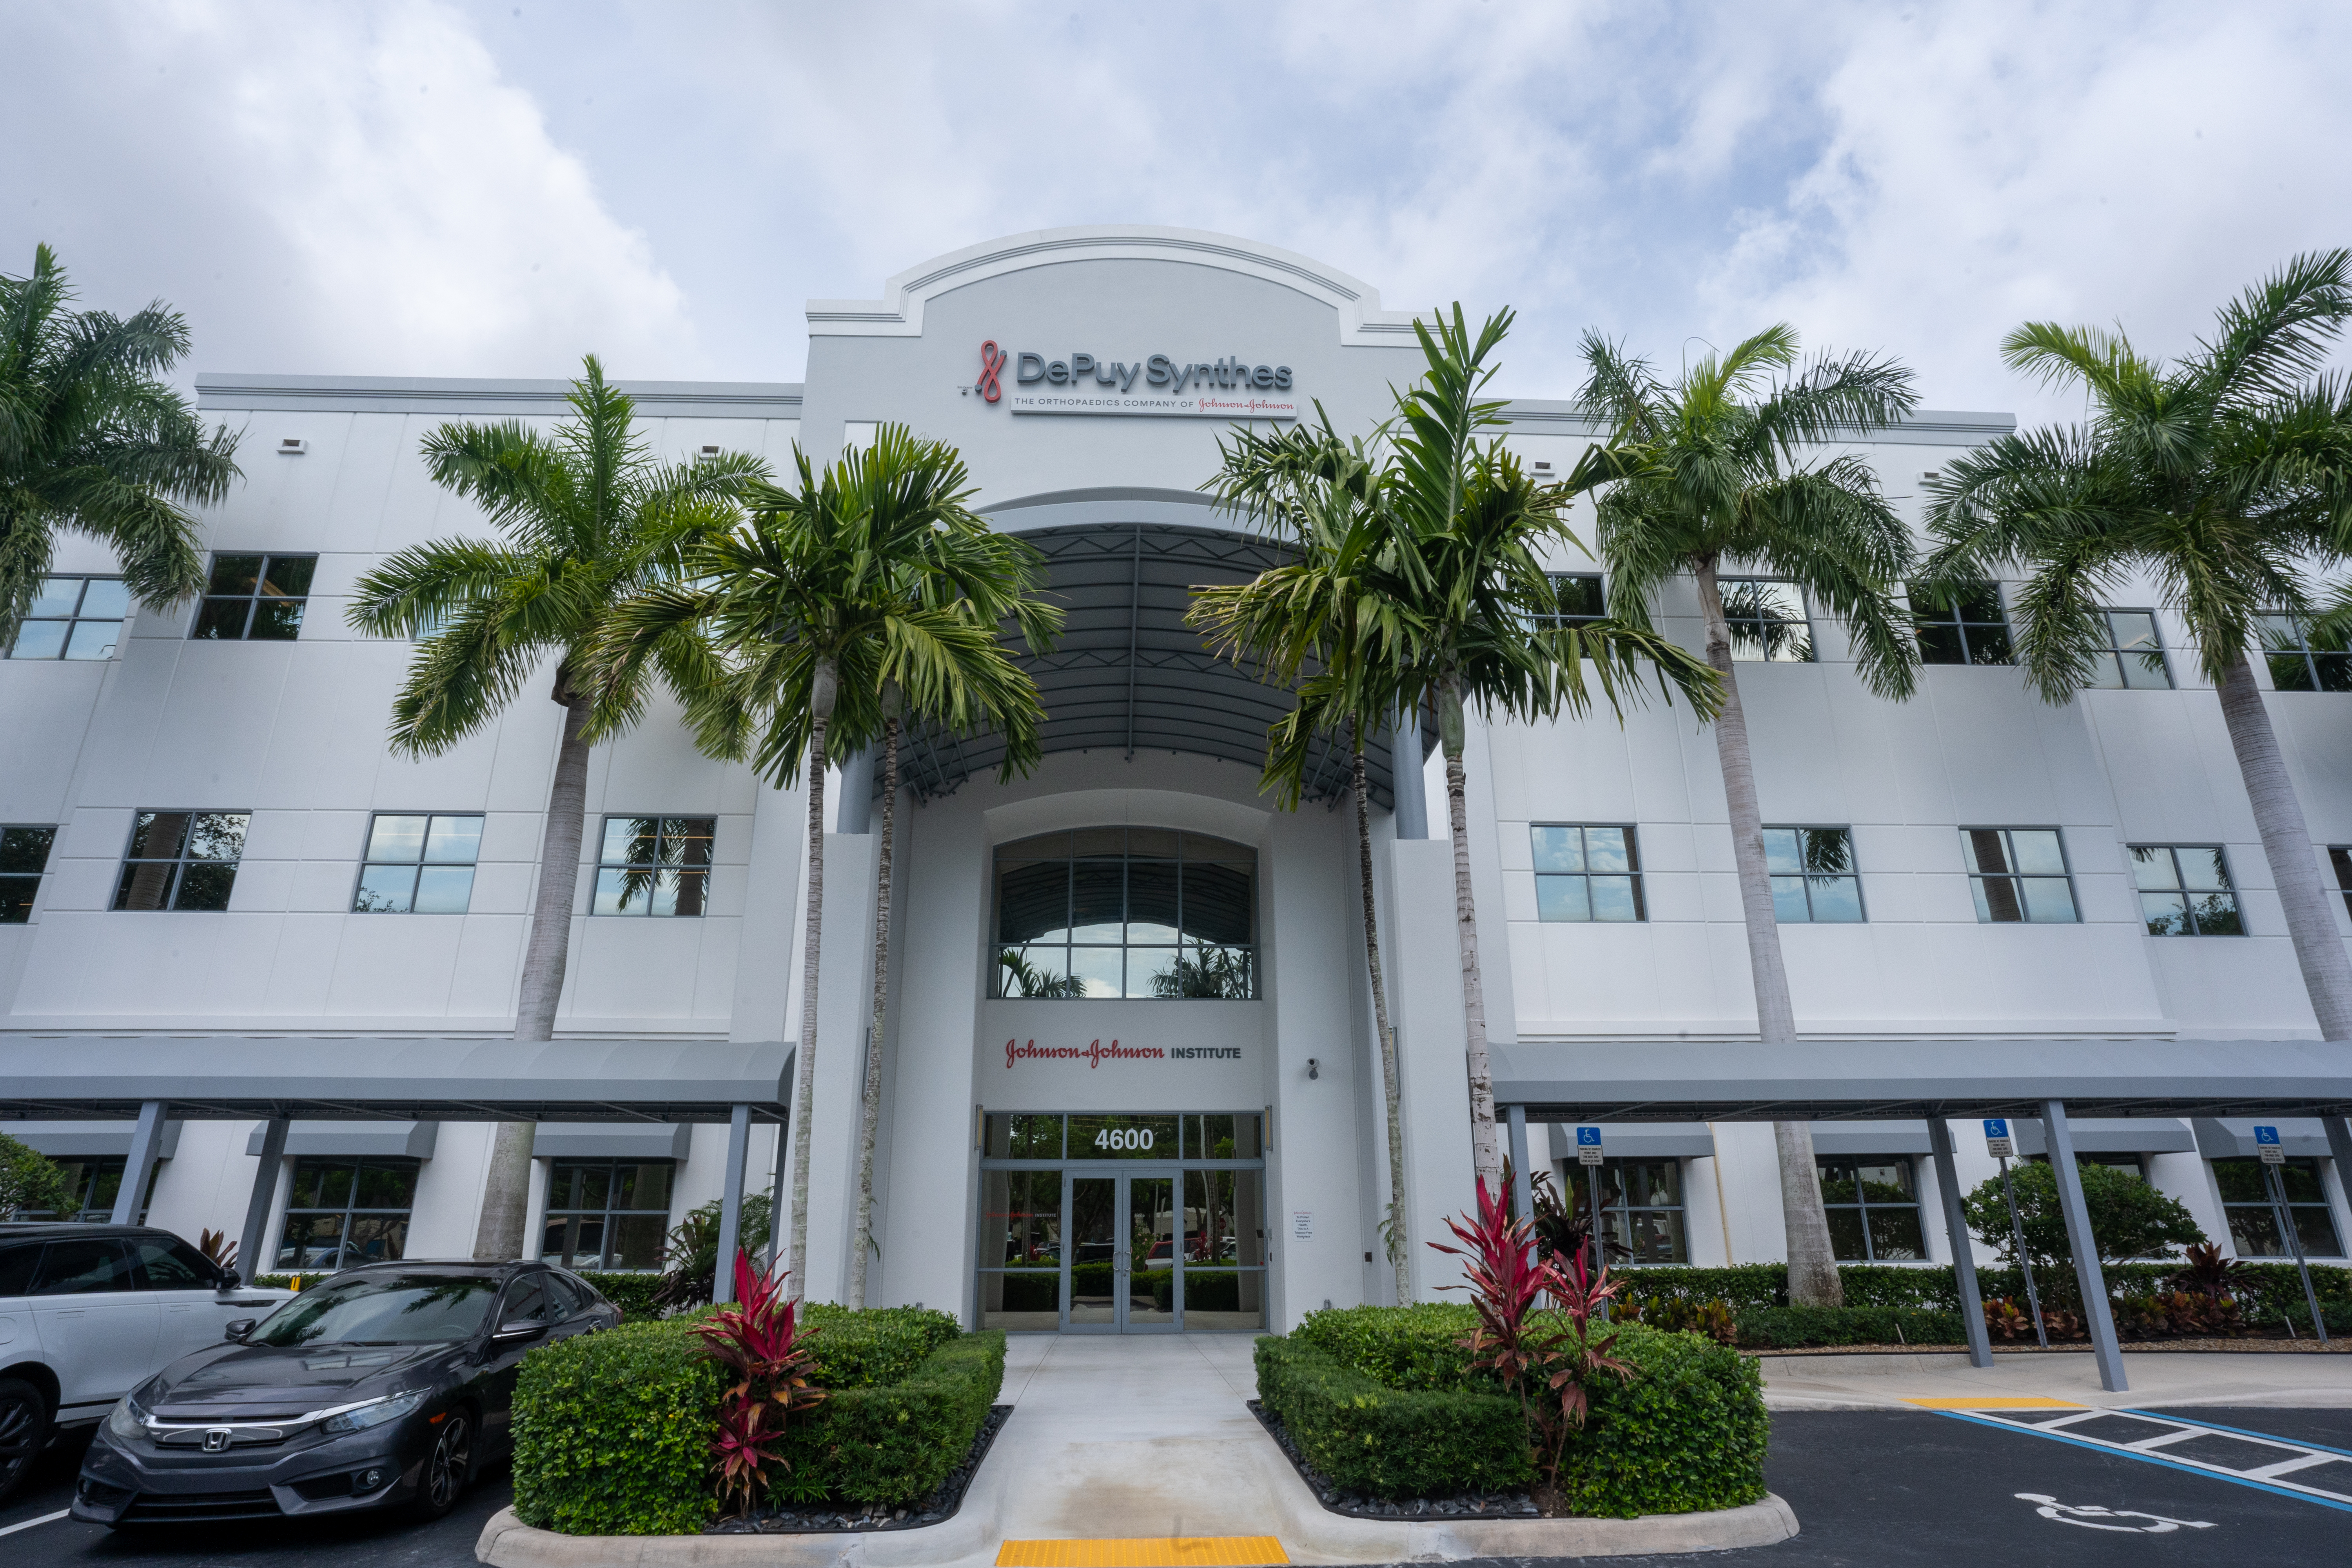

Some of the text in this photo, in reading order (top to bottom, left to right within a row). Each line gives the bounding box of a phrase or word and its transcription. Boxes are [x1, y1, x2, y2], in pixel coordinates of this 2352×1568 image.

[1017, 352, 1293, 393] DePuy Synthes
[1038, 398, 1120, 407] ORTHOPAEDICS
[1171, 1047, 1241, 1059] INSTITUTE
[1095, 1129, 1153, 1150] 4600
